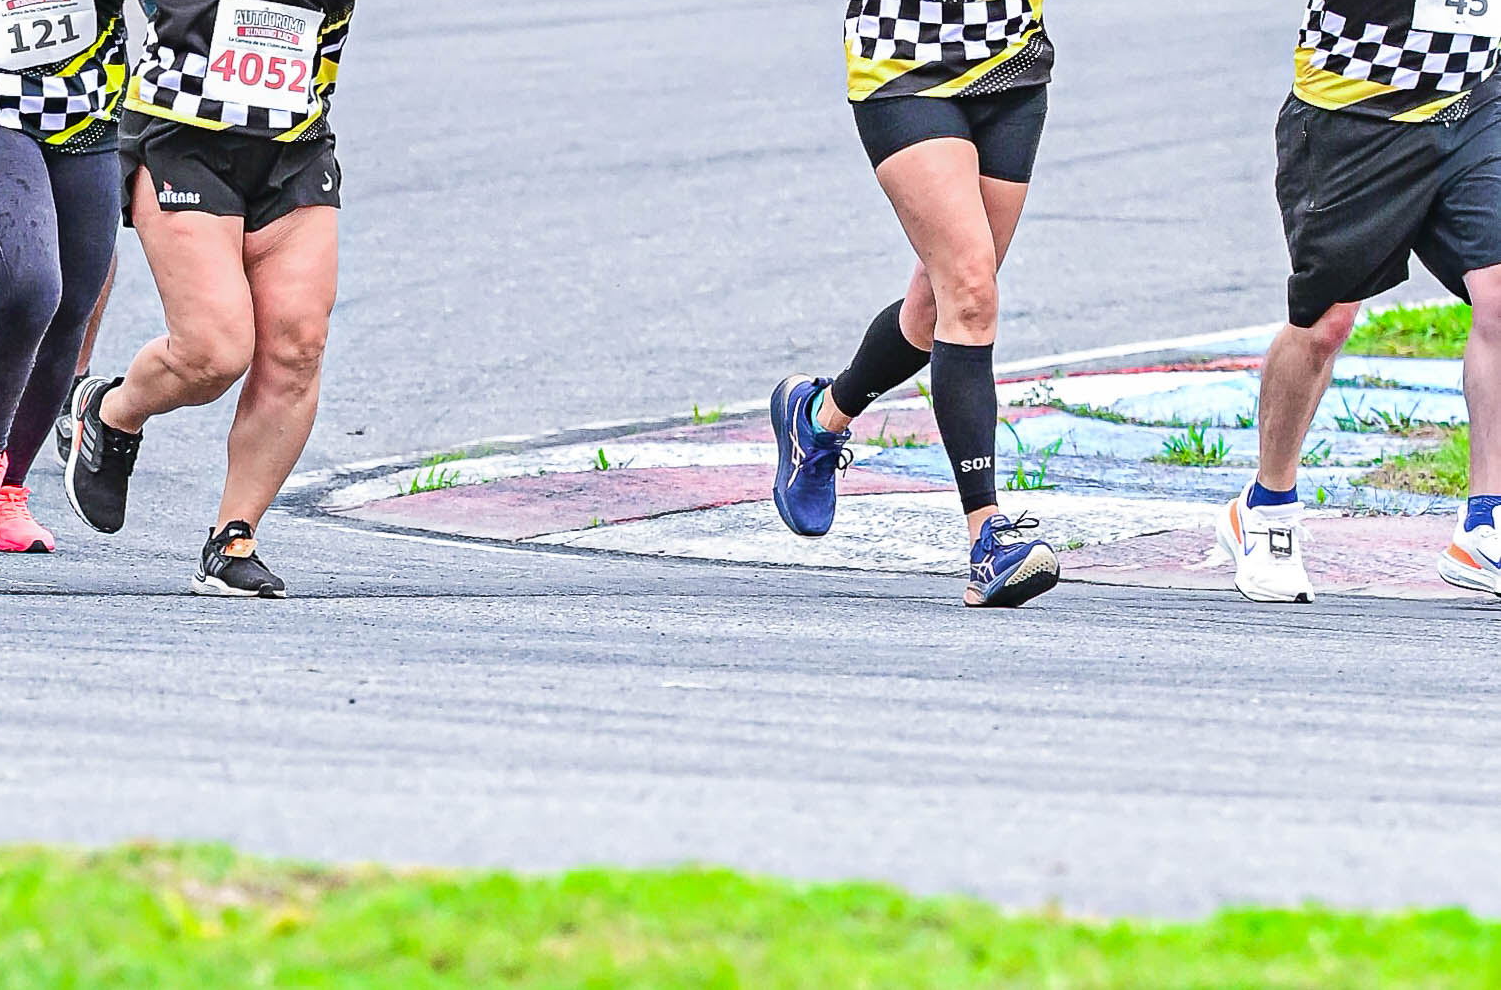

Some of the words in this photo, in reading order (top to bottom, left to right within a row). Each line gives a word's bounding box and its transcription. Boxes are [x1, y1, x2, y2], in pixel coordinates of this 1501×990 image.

[7, 14, 80, 54] 121
[234, 7, 306, 34] AUTÓDROMO
[210, 50, 307, 93] 4052
[158, 190, 201, 204] ATENAS
[960, 456, 992, 473] SOX
